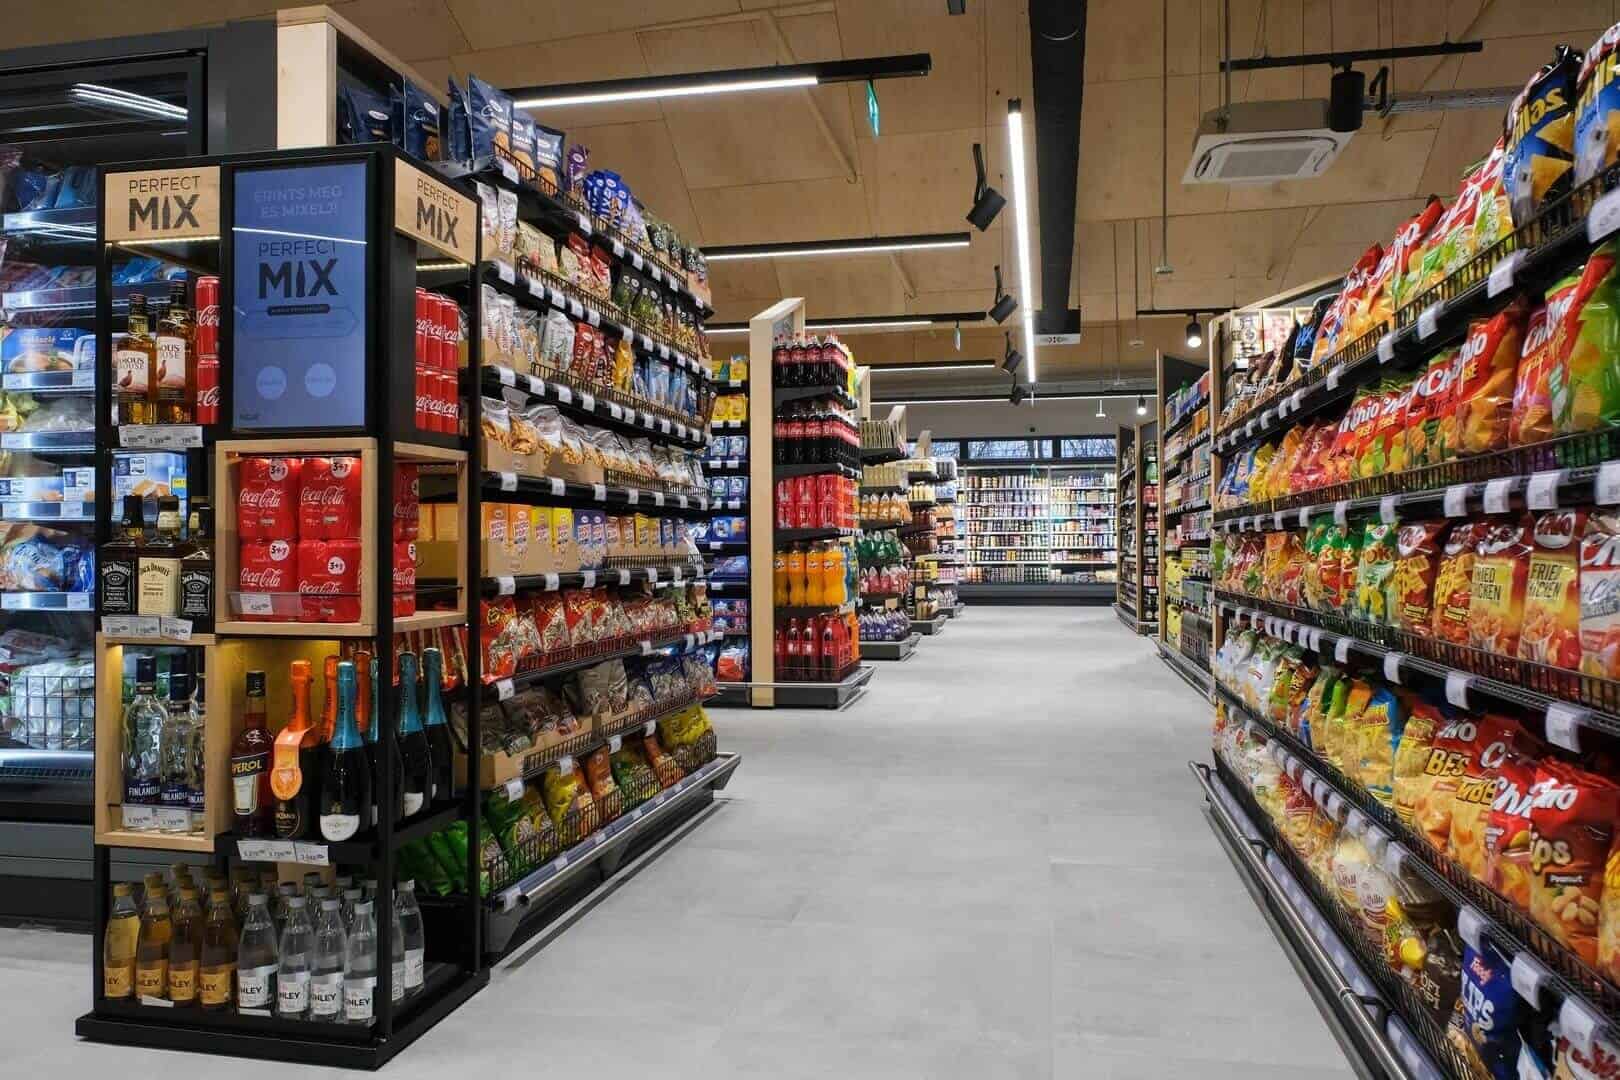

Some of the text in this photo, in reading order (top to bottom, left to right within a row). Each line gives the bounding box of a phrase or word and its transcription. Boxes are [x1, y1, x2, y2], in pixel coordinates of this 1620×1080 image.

[129, 175, 201, 192] PERFECT
[416, 177, 461, 211] PERFECT
[128, 194, 201, 232] MIX
[416, 196, 459, 249] MIX
[257, 239, 336, 257] PERFECT
[257, 258, 340, 299] MIX
